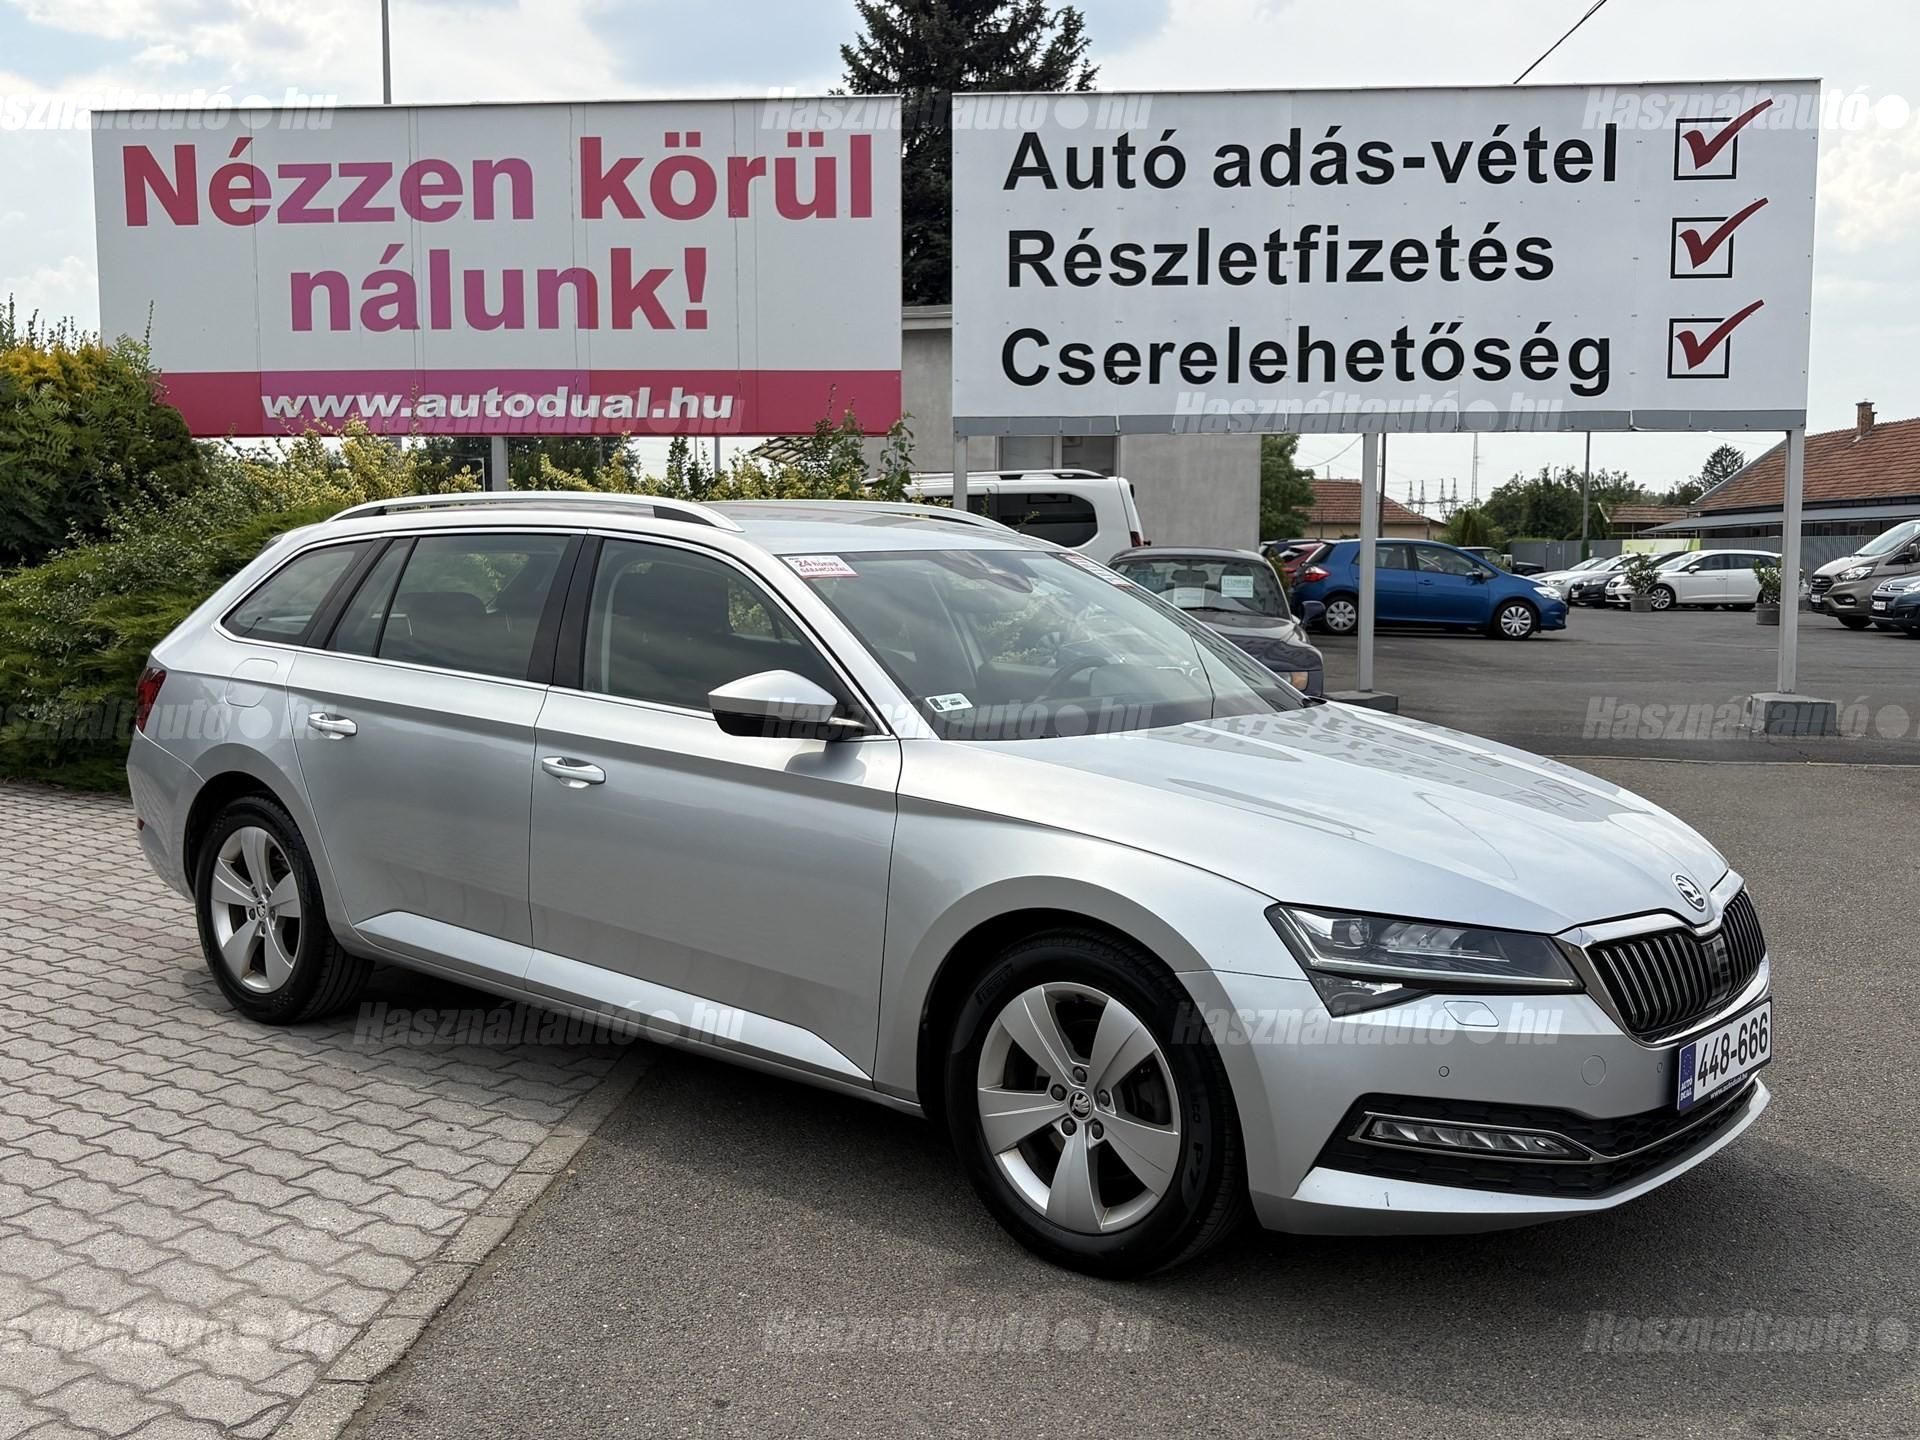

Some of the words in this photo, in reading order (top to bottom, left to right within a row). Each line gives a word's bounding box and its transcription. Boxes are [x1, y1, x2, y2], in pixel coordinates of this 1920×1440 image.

[122, 136, 535, 226] Nézzen
[581, 131, 873, 220] körül
[1003, 128, 1187, 191] Autó
[1213, 122, 1617, 188] adás-vétel
[290, 243, 708, 332] nálunk!
[1008, 221, 1554, 290] Részletfizetés
[1001, 320, 1611, 398] Cserelehetőség
[261, 386, 734, 420] www.autodual.hu
[1698, 1012, 1768, 1087] 448-666
